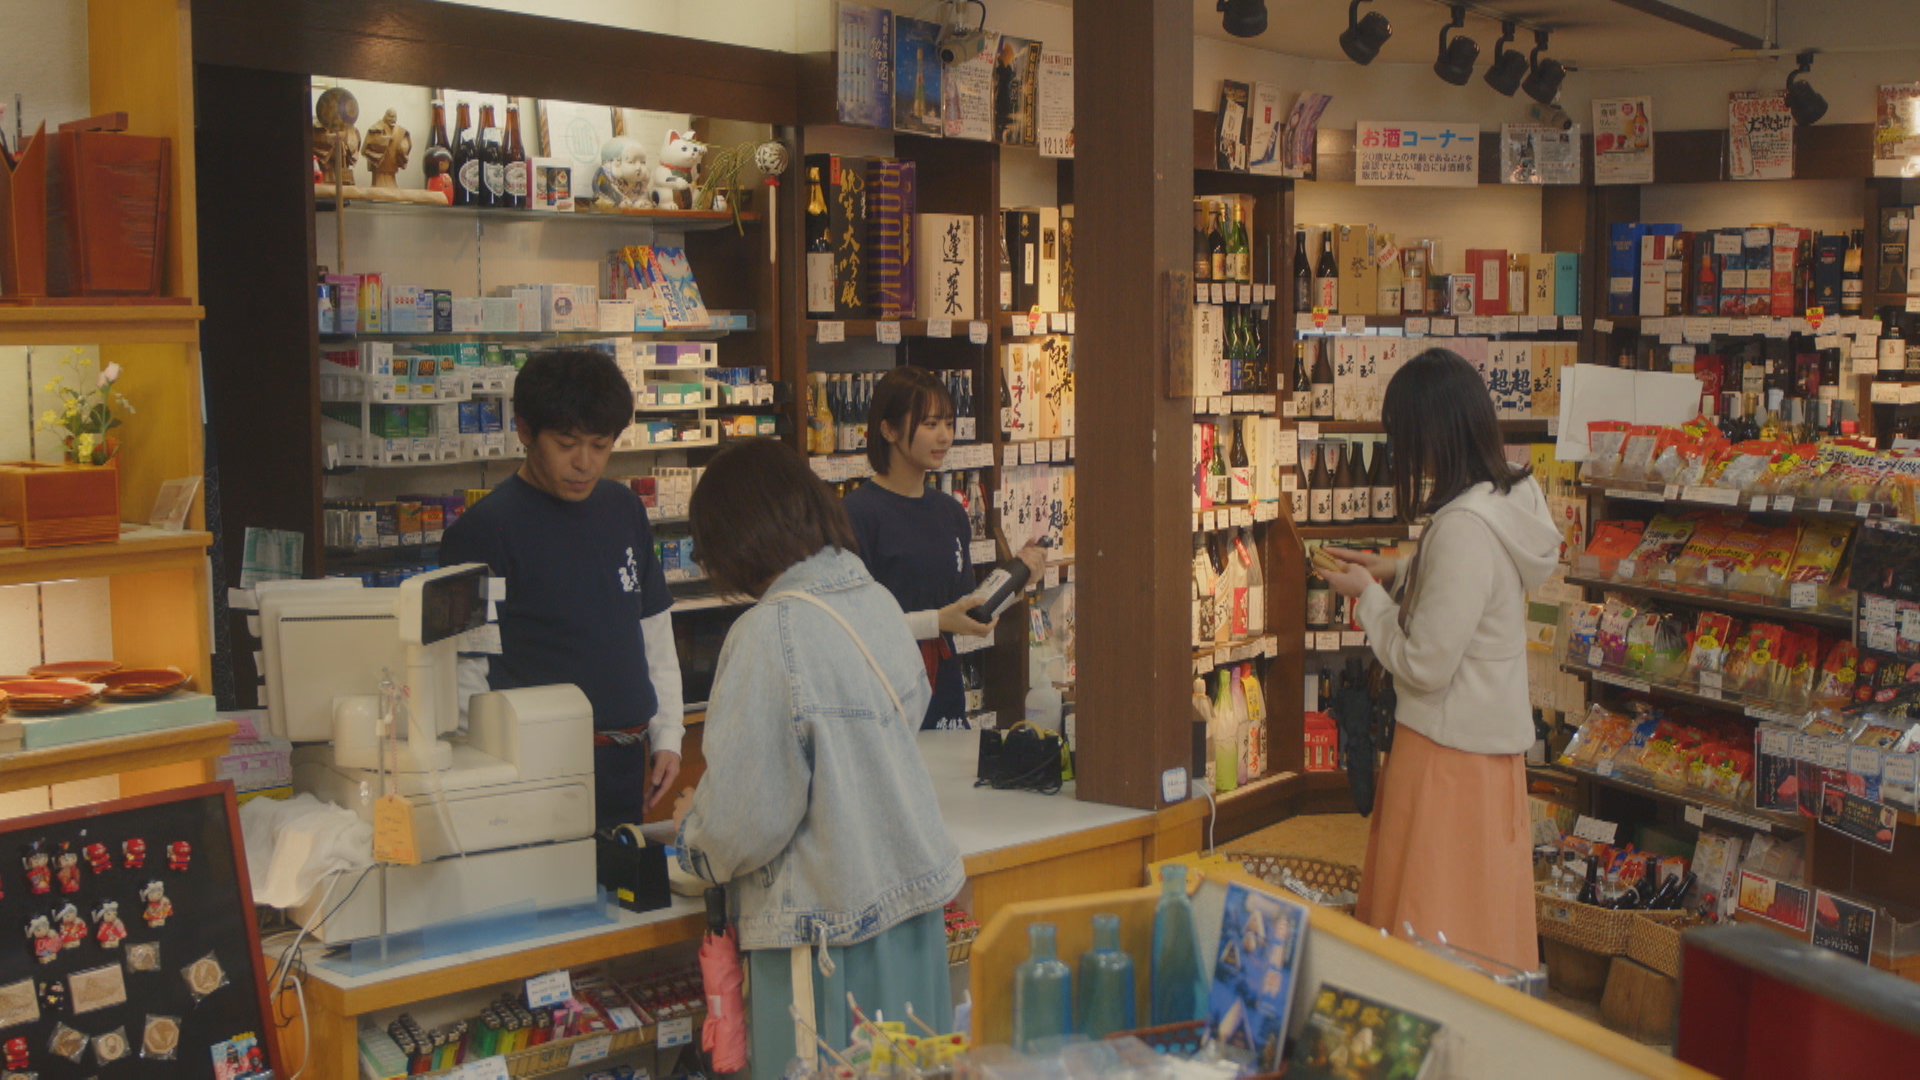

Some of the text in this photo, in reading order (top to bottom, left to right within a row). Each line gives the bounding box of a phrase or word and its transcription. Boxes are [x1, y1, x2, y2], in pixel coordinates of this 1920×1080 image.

[1361, 127, 1475, 148] お酒コーナー
